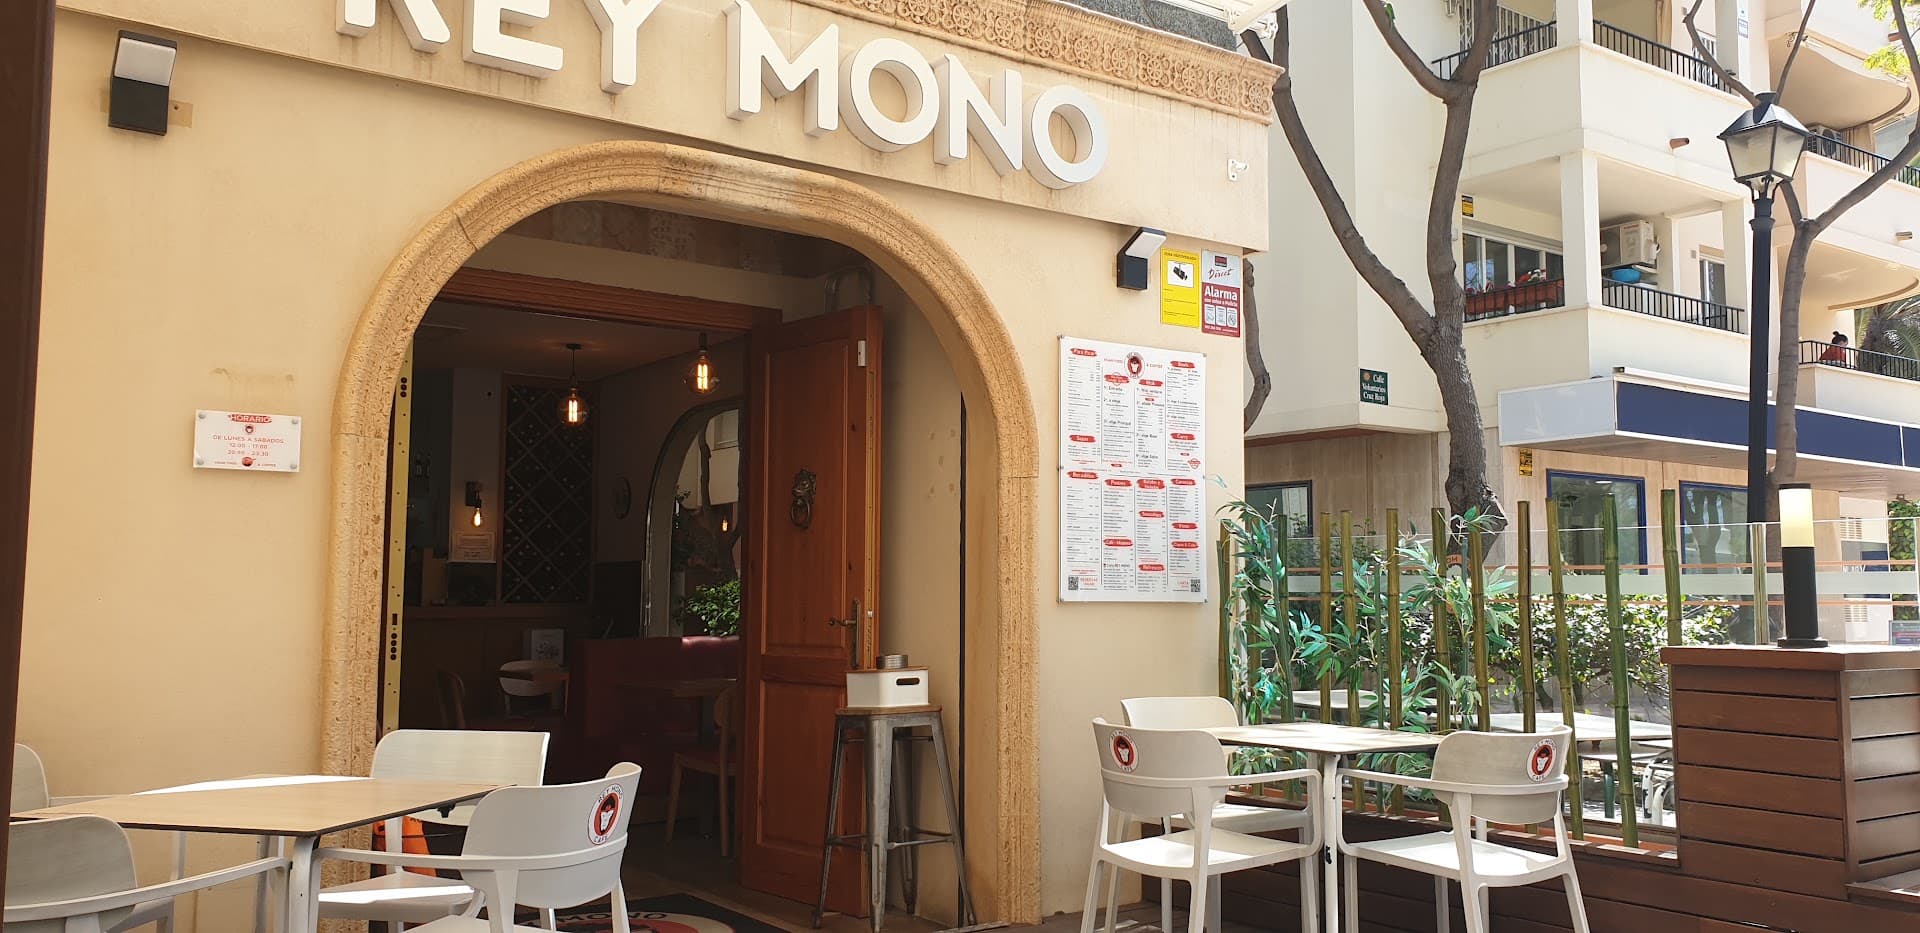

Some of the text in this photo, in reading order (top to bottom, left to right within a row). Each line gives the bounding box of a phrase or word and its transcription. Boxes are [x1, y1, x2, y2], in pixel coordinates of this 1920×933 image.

[727, 0, 1108, 190] MONO
[1204, 286, 1238, 300] Alarma
[1373, 374, 1385, 384] Calle
[1362, 383, 1386, 393] Voluntarios
[1363, 392, 1385, 403] Cruz Roja
[229, 414, 271, 423] HORARIO
